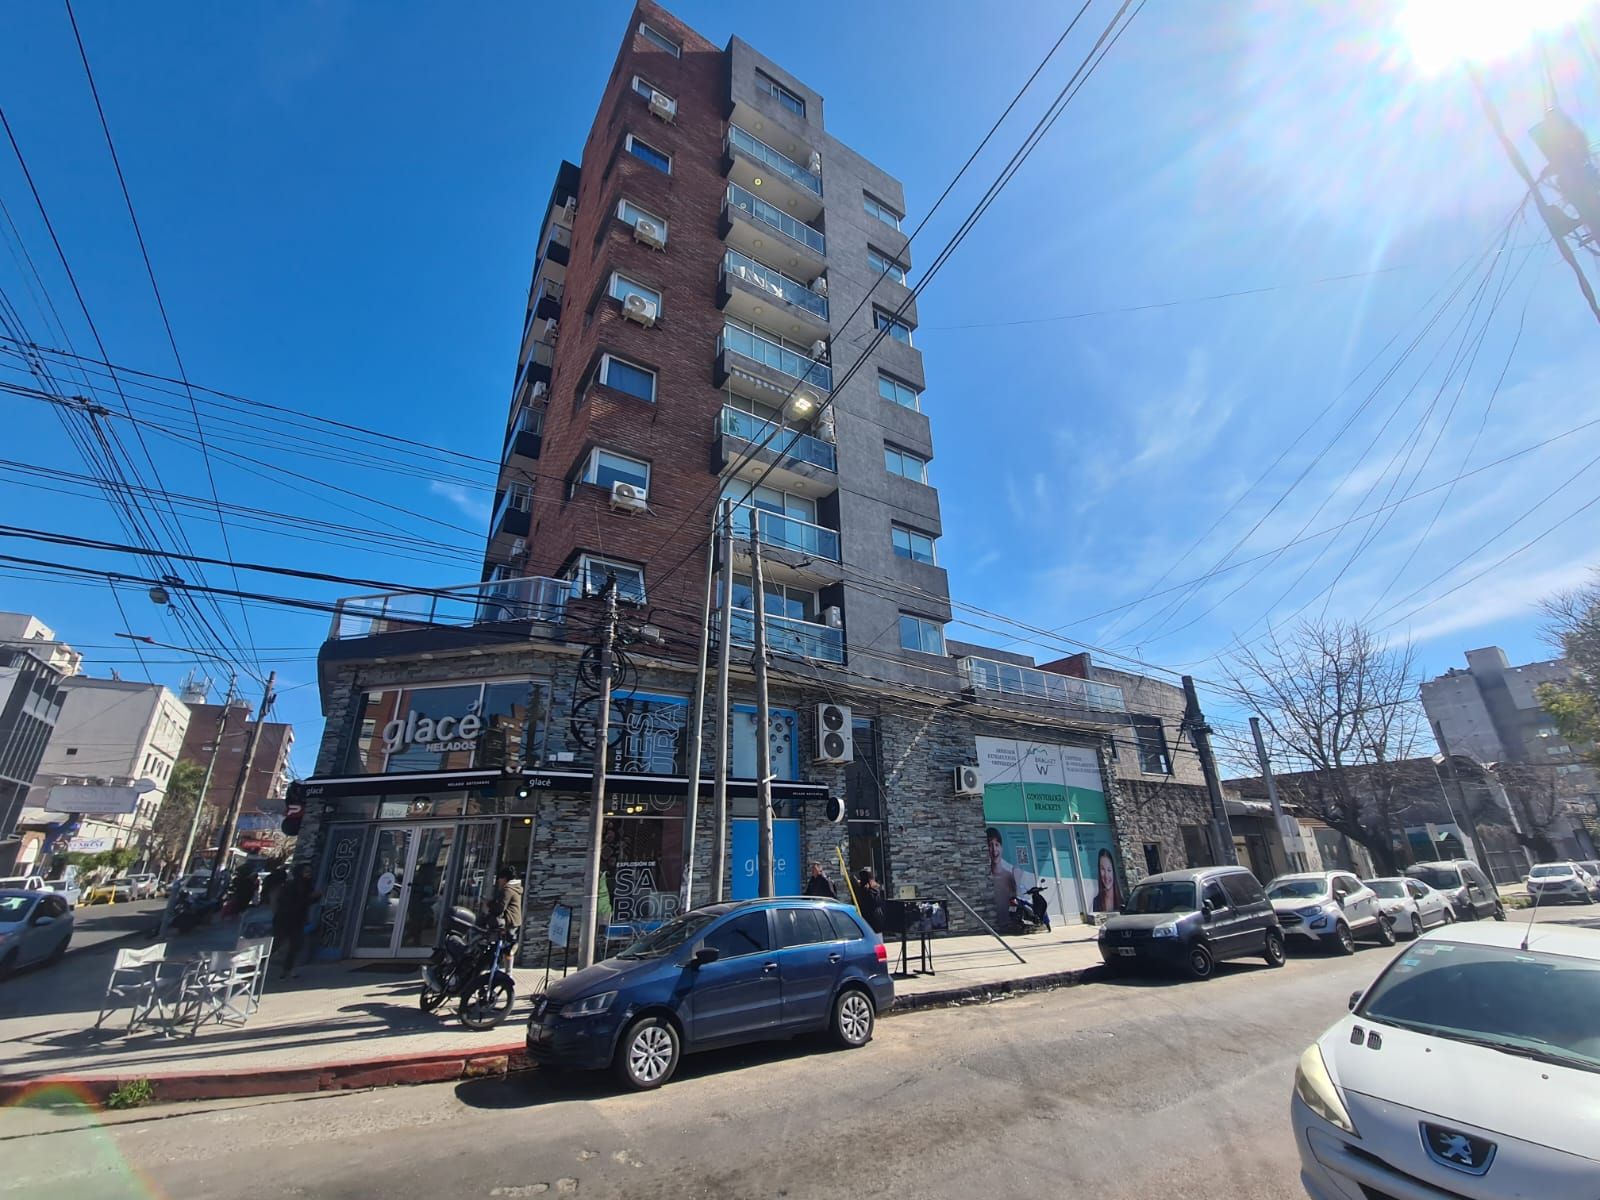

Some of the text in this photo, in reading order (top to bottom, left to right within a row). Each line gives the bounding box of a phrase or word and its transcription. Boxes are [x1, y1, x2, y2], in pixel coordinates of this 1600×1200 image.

[426, 741, 477, 753] HELADOS
[529, 778, 552, 788] glacé
[614, 868, 658, 897] SA
